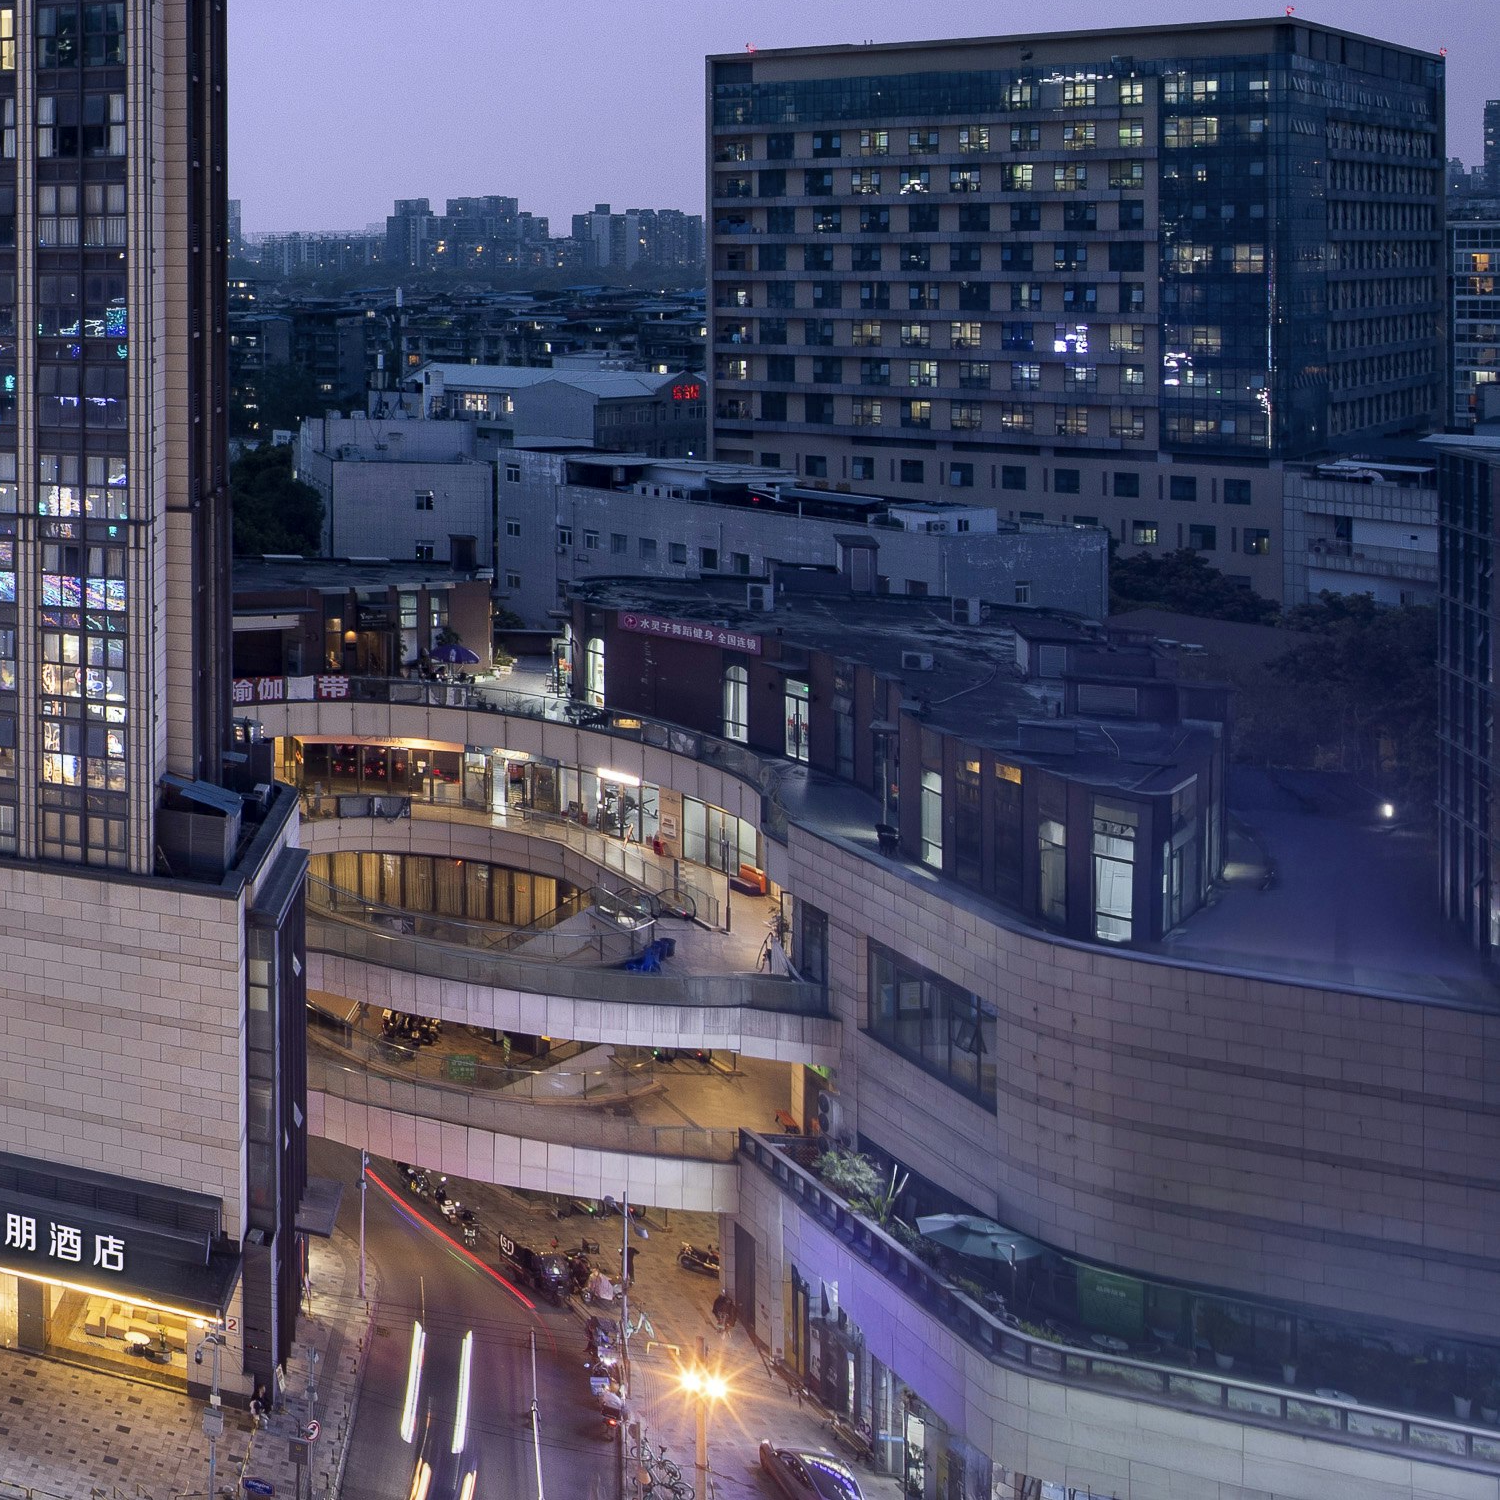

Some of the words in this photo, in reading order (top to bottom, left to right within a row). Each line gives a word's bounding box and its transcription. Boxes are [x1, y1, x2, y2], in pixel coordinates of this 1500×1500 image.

[640, 618, 714, 641] 水灵子舞蹈健身
[717, 633, 756, 651] 全国连锁
[233, 677, 283, 702] 瑜伽
